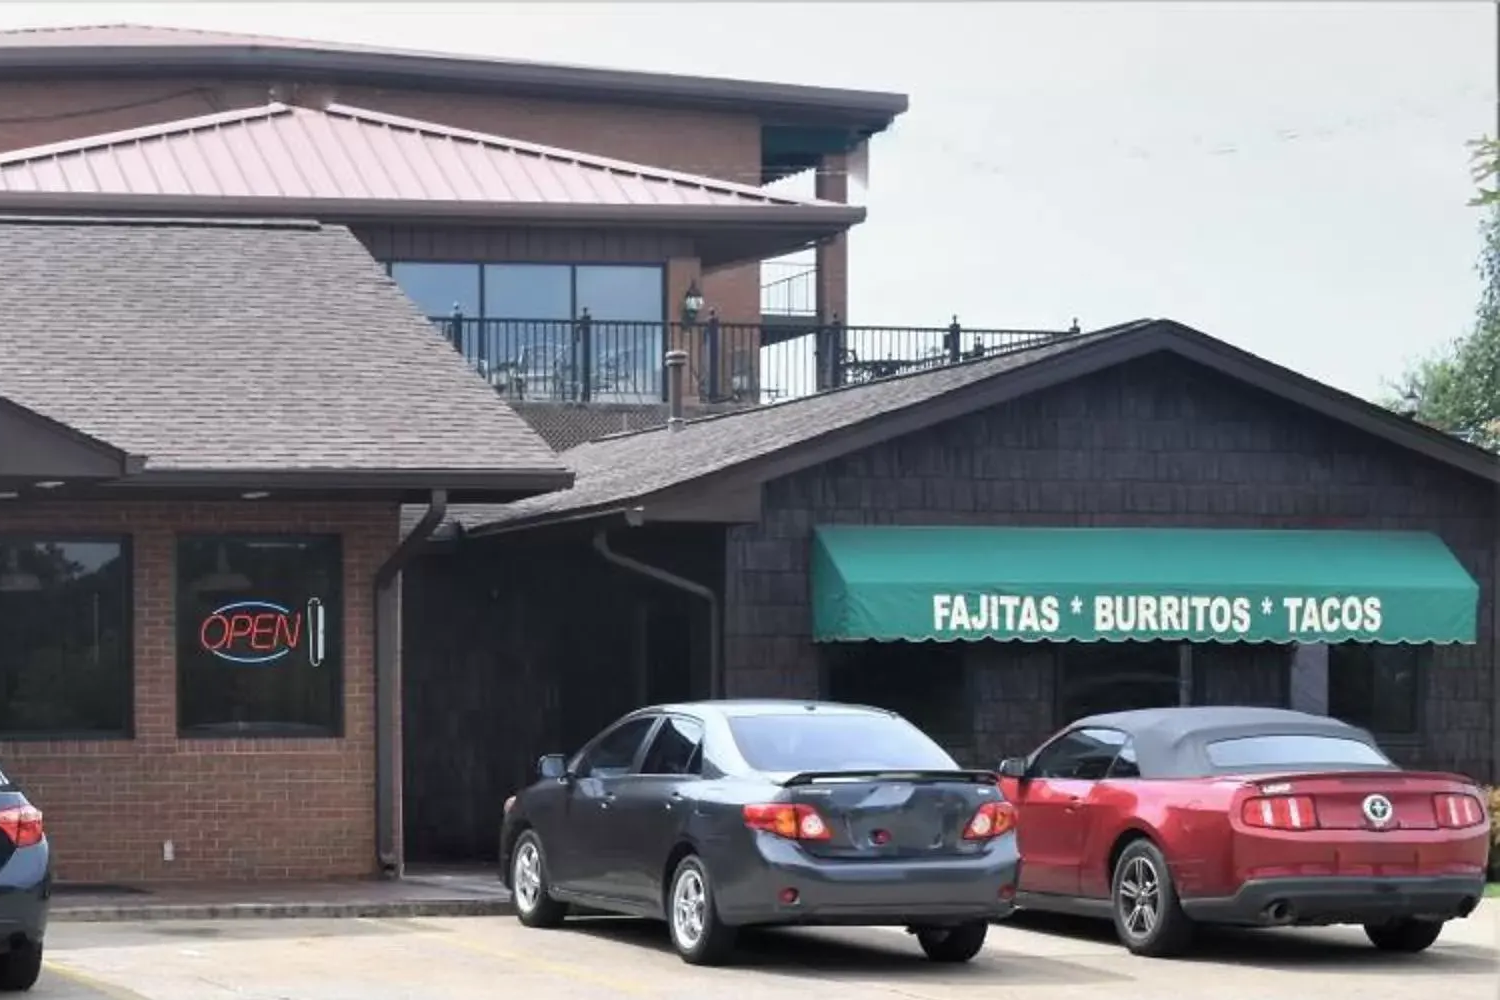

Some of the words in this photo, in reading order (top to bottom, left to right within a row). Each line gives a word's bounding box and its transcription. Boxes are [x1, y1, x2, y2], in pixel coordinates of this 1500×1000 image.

[201, 612, 301, 650] OPEN
[933, 594, 1060, 633] FAJITAS
[1094, 595, 1251, 633] BURRITOS
[1283, 596, 1382, 633] TACOS
